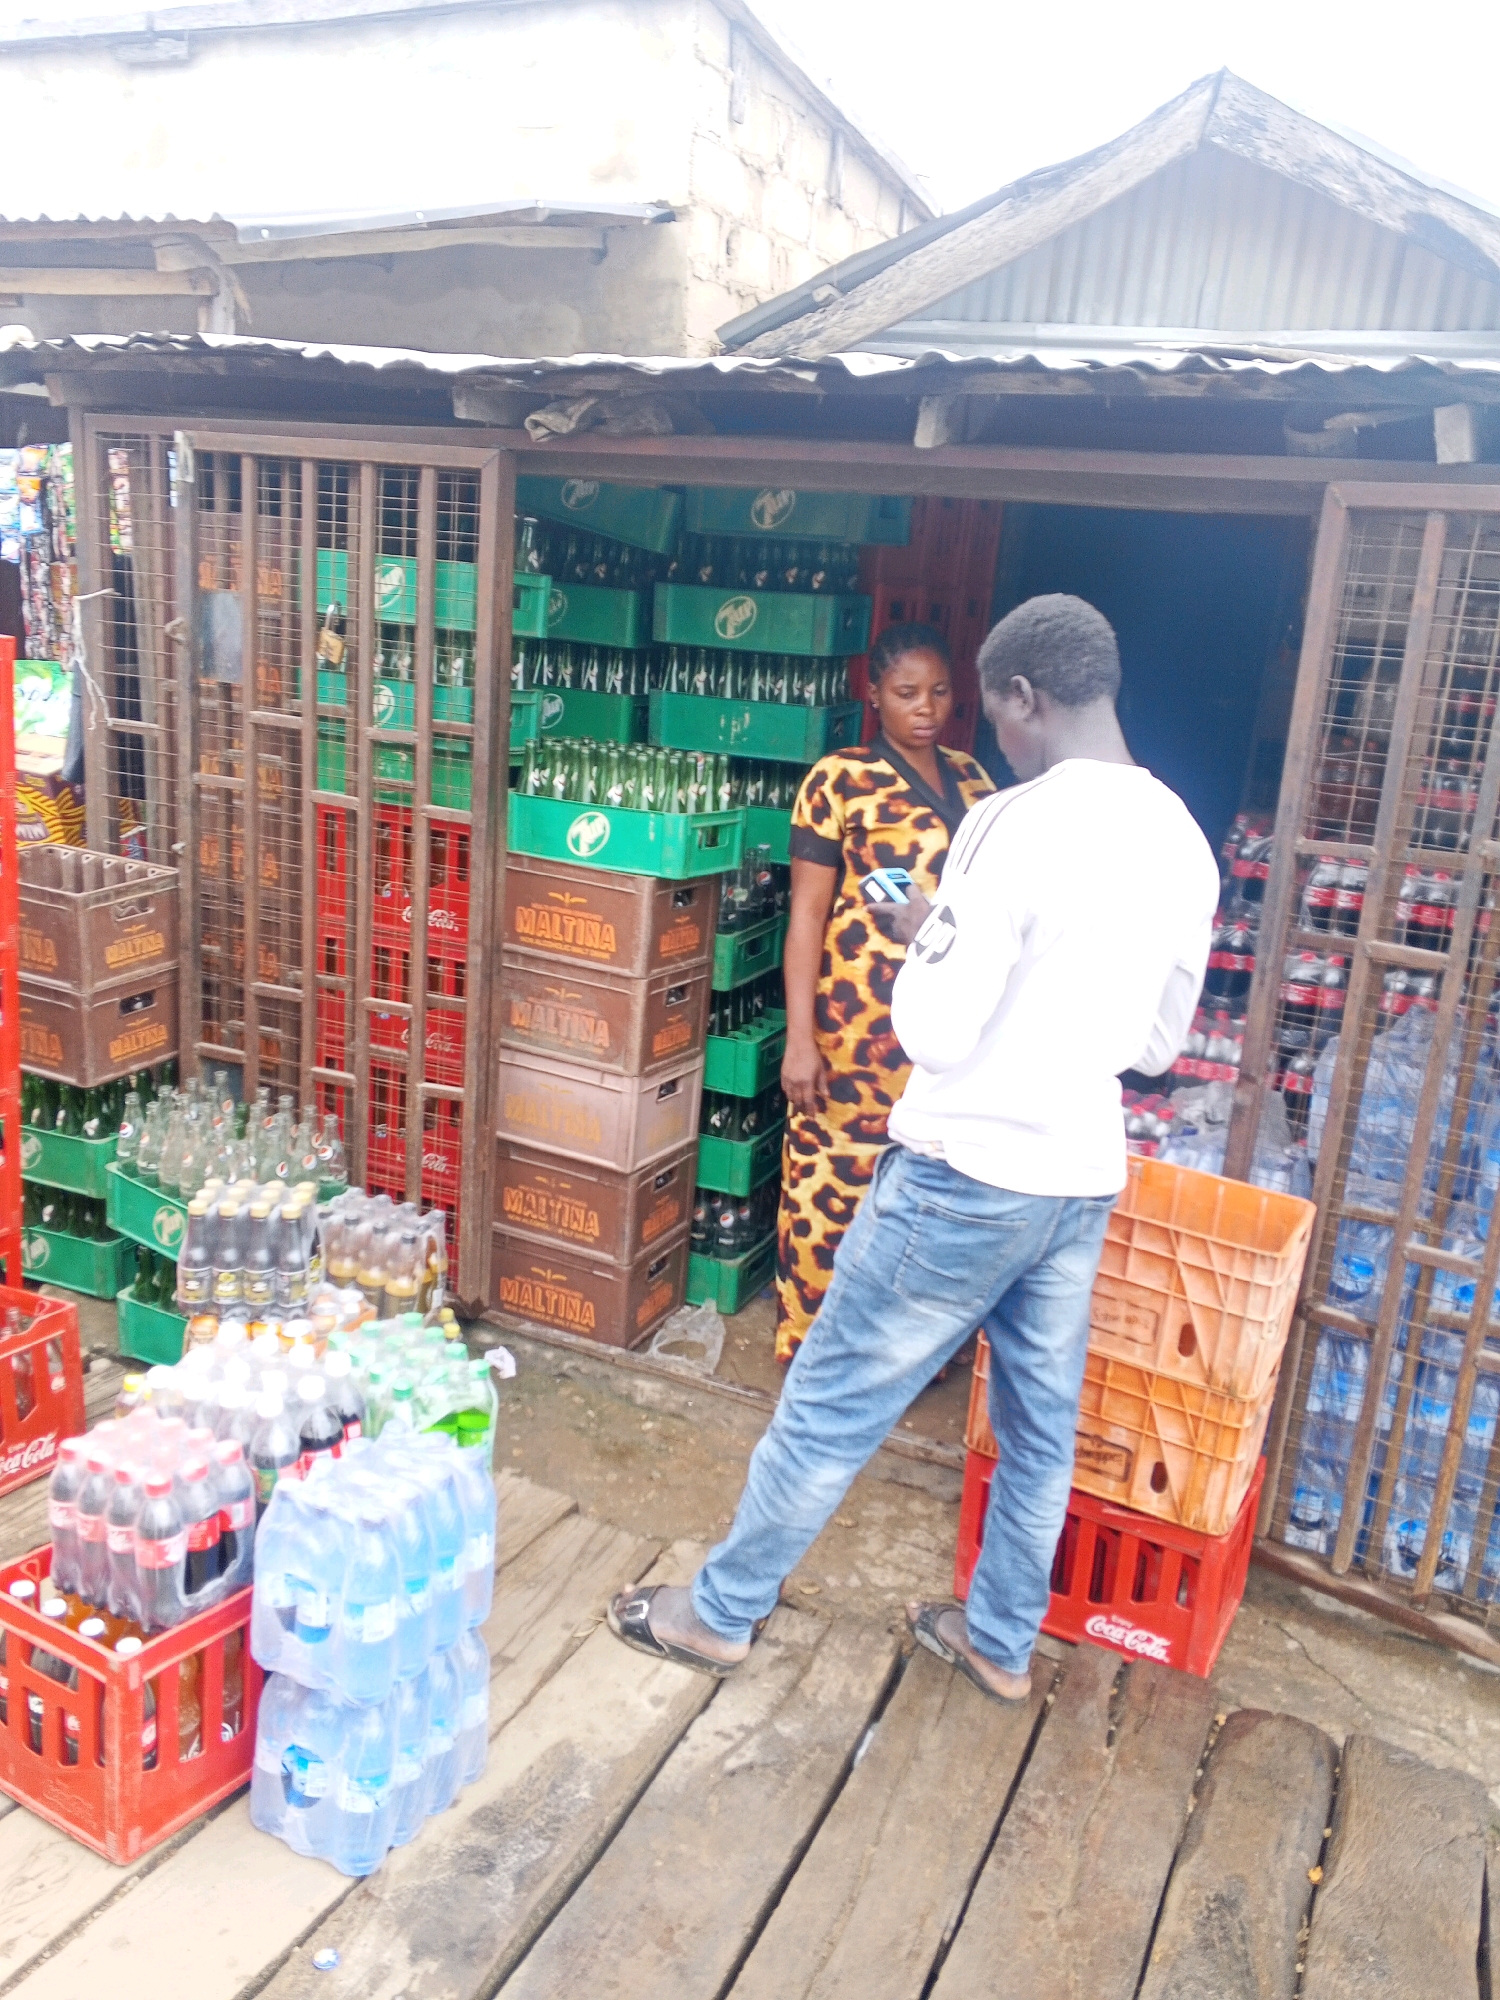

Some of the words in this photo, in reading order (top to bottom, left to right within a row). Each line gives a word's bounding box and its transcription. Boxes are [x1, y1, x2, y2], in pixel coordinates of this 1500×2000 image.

[515, 905, 616, 953] MALTINA
[510, 1000, 610, 1047] MALTINA
[503, 1187, 600, 1238] MALTINA
[500, 1277, 595, 1329] MALTINA
